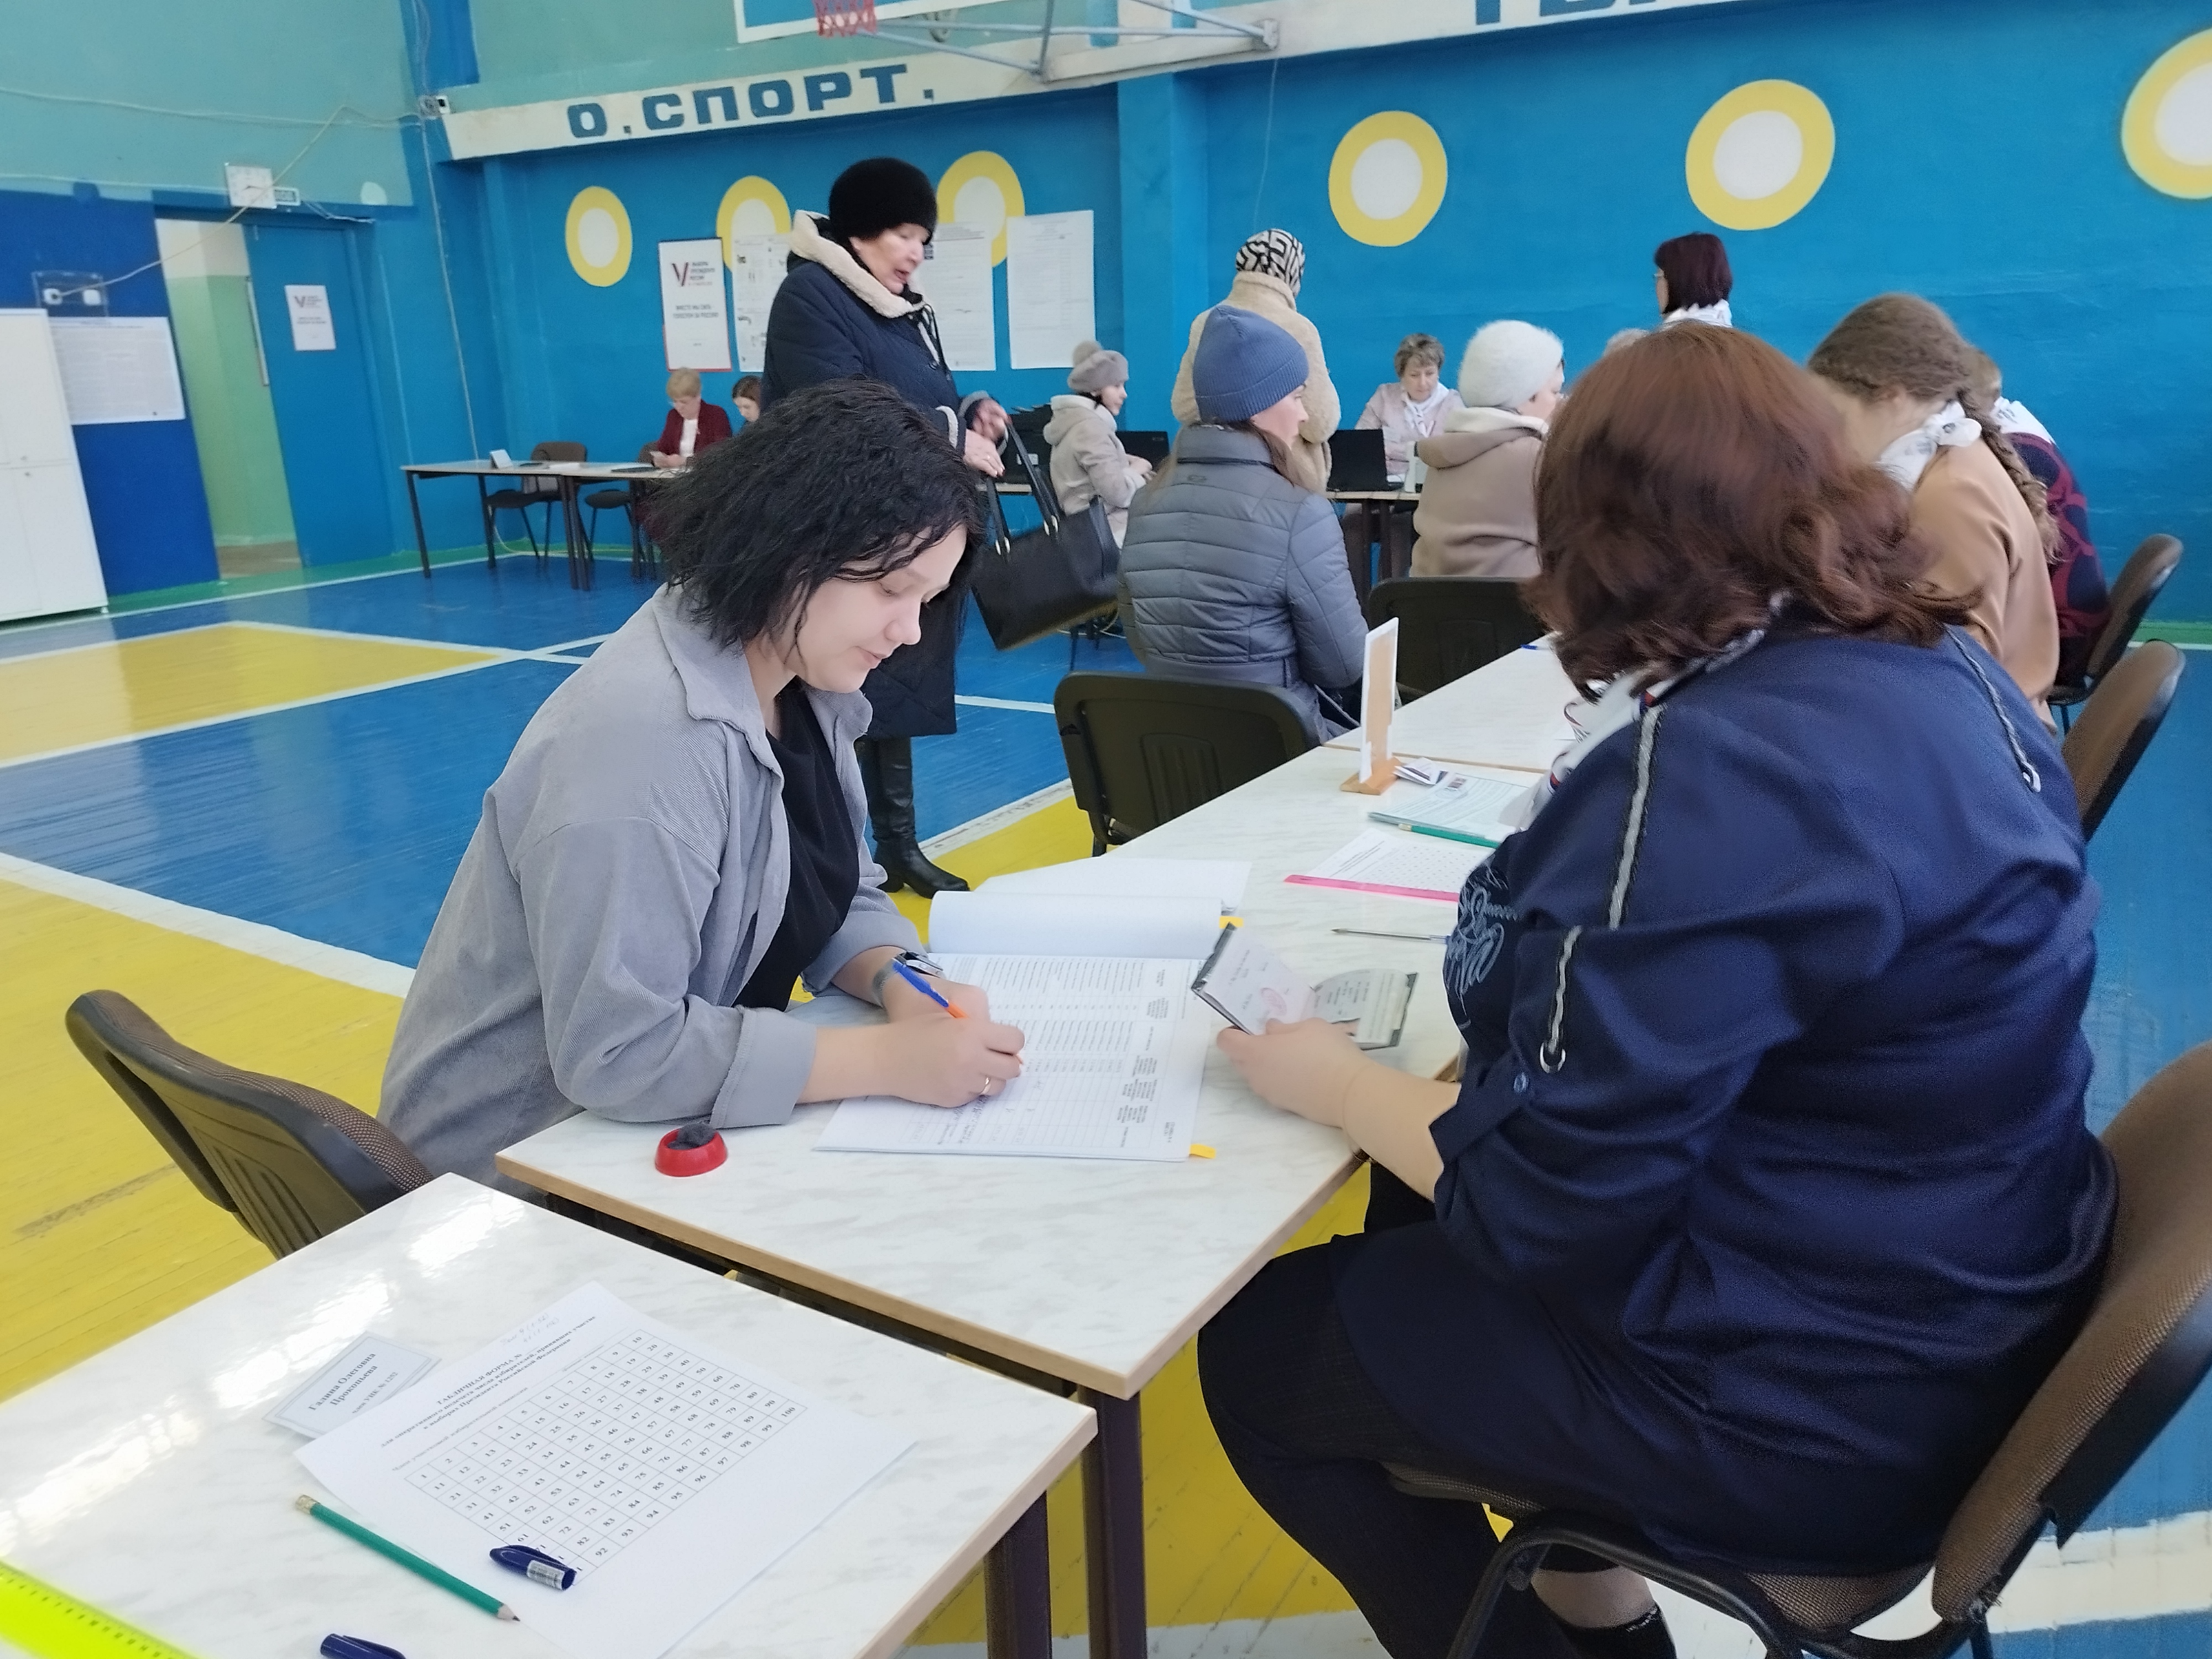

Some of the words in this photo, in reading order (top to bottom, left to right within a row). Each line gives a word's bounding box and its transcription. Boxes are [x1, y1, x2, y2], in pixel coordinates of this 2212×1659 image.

[308, 1385, 341, 1411] Галина
[337, 1353, 376, 1384] Олеговна
[330, 1365, 378, 1406] Прокопьева
[384, 1371, 398, 1383] 1252
[394, 1409, 444, 1439] оперативного
[444, 1390, 474, 1410] подсчета
[474, 1378, 494, 1390] числа
[494, 1353, 537, 1379] избирателей,
[429, 1407, 460, 1426] выборах
[459, 1383, 499, 1407] Президента
[498, 1360, 536, 1384] Российской
[536, 1339, 571, 1360] Федерации
[436, 1375, 486, 1405] ТАБЛИЧНАЯ
[485, 1359, 514, 1376] ФОРМА
[434, 1482, 445, 1490] 11
[458, 1466, 471, 1474] 12
[484, 1449, 496, 1457] 13
[581, 1386, 591, 1395] 17
[449, 1492, 462, 1501] 21
[473, 1475, 487, 1485] 22
[500, 1459, 513, 1468] 23
[525, 1441, 538, 1451] 24
[549, 1425, 562, 1434] 25
[597, 1395, 607, 1404] 27
[619, 1380, 631, 1388] 28
[466, 1502, 478, 1511] 31
[490, 1485, 503, 1494] 32
[517, 1468, 529, 1477] 33
[541, 1451, 554, 1459] 34
[566, 1434, 578, 1443] 35
[613, 1403, 624, 1412] 37
[635, 1387, 648, 1396] 38
[499, 1522, 512, 1532] 51
[524, 1505, 537, 1514] 52
[550, 1488, 562, 1497] 53
[575, 1470, 588, 1479] 54
[599, 1452, 612, 1462] 55
[624, 1437, 635, 1445] 56
[646, 1420, 658, 1430] 57
[669, 1405, 681, 1413] 58
[508, 1495, 520, 1504] 42
[535, 1478, 545, 1486] 43
[560, 1460, 571, 1469] 44
[584, 1443, 594, 1452] 45
[631, 1412, 640, 1420] 47
[517, 1533, 529, 1542] 61
[542, 1515, 554, 1525] 62
[568, 1498, 580, 1506] 63
[593, 1480, 605, 1489] 64
[618, 1462, 629, 1471] 65
[641, 1446, 653, 1454] 66
[665, 1429, 675, 1438] 67
[709, 1398, 719, 1406] 69
[558, 1526, 572, 1535] 72
[585, 1507, 597, 1516] 73
[634, 1472, 647, 1480] 75
[681, 1438, 692, 1447] 77
[747, 1391, 758, 1400] 80
[576, 1537, 590, 1546] 82
[603, 1517, 615, 1527] 83
[628, 1499, 640, 1509] 84
[652, 1481, 665, 1491] 85
[676, 1465, 688, 1473] 86
[699, 1447, 710, 1456] 87
[722, 1431, 733, 1439] 88
[595, 1547, 608, 1557] 92
[621, 1528, 634, 1537] 93
[646, 1510, 659, 1519] 94
[671, 1491, 683, 1500] 95
[694, 1474, 707, 1483] 96
[717, 1457, 728, 1465] 97
[761, 1424, 772, 1432] 99
[781, 1407, 796, 1417] 100
